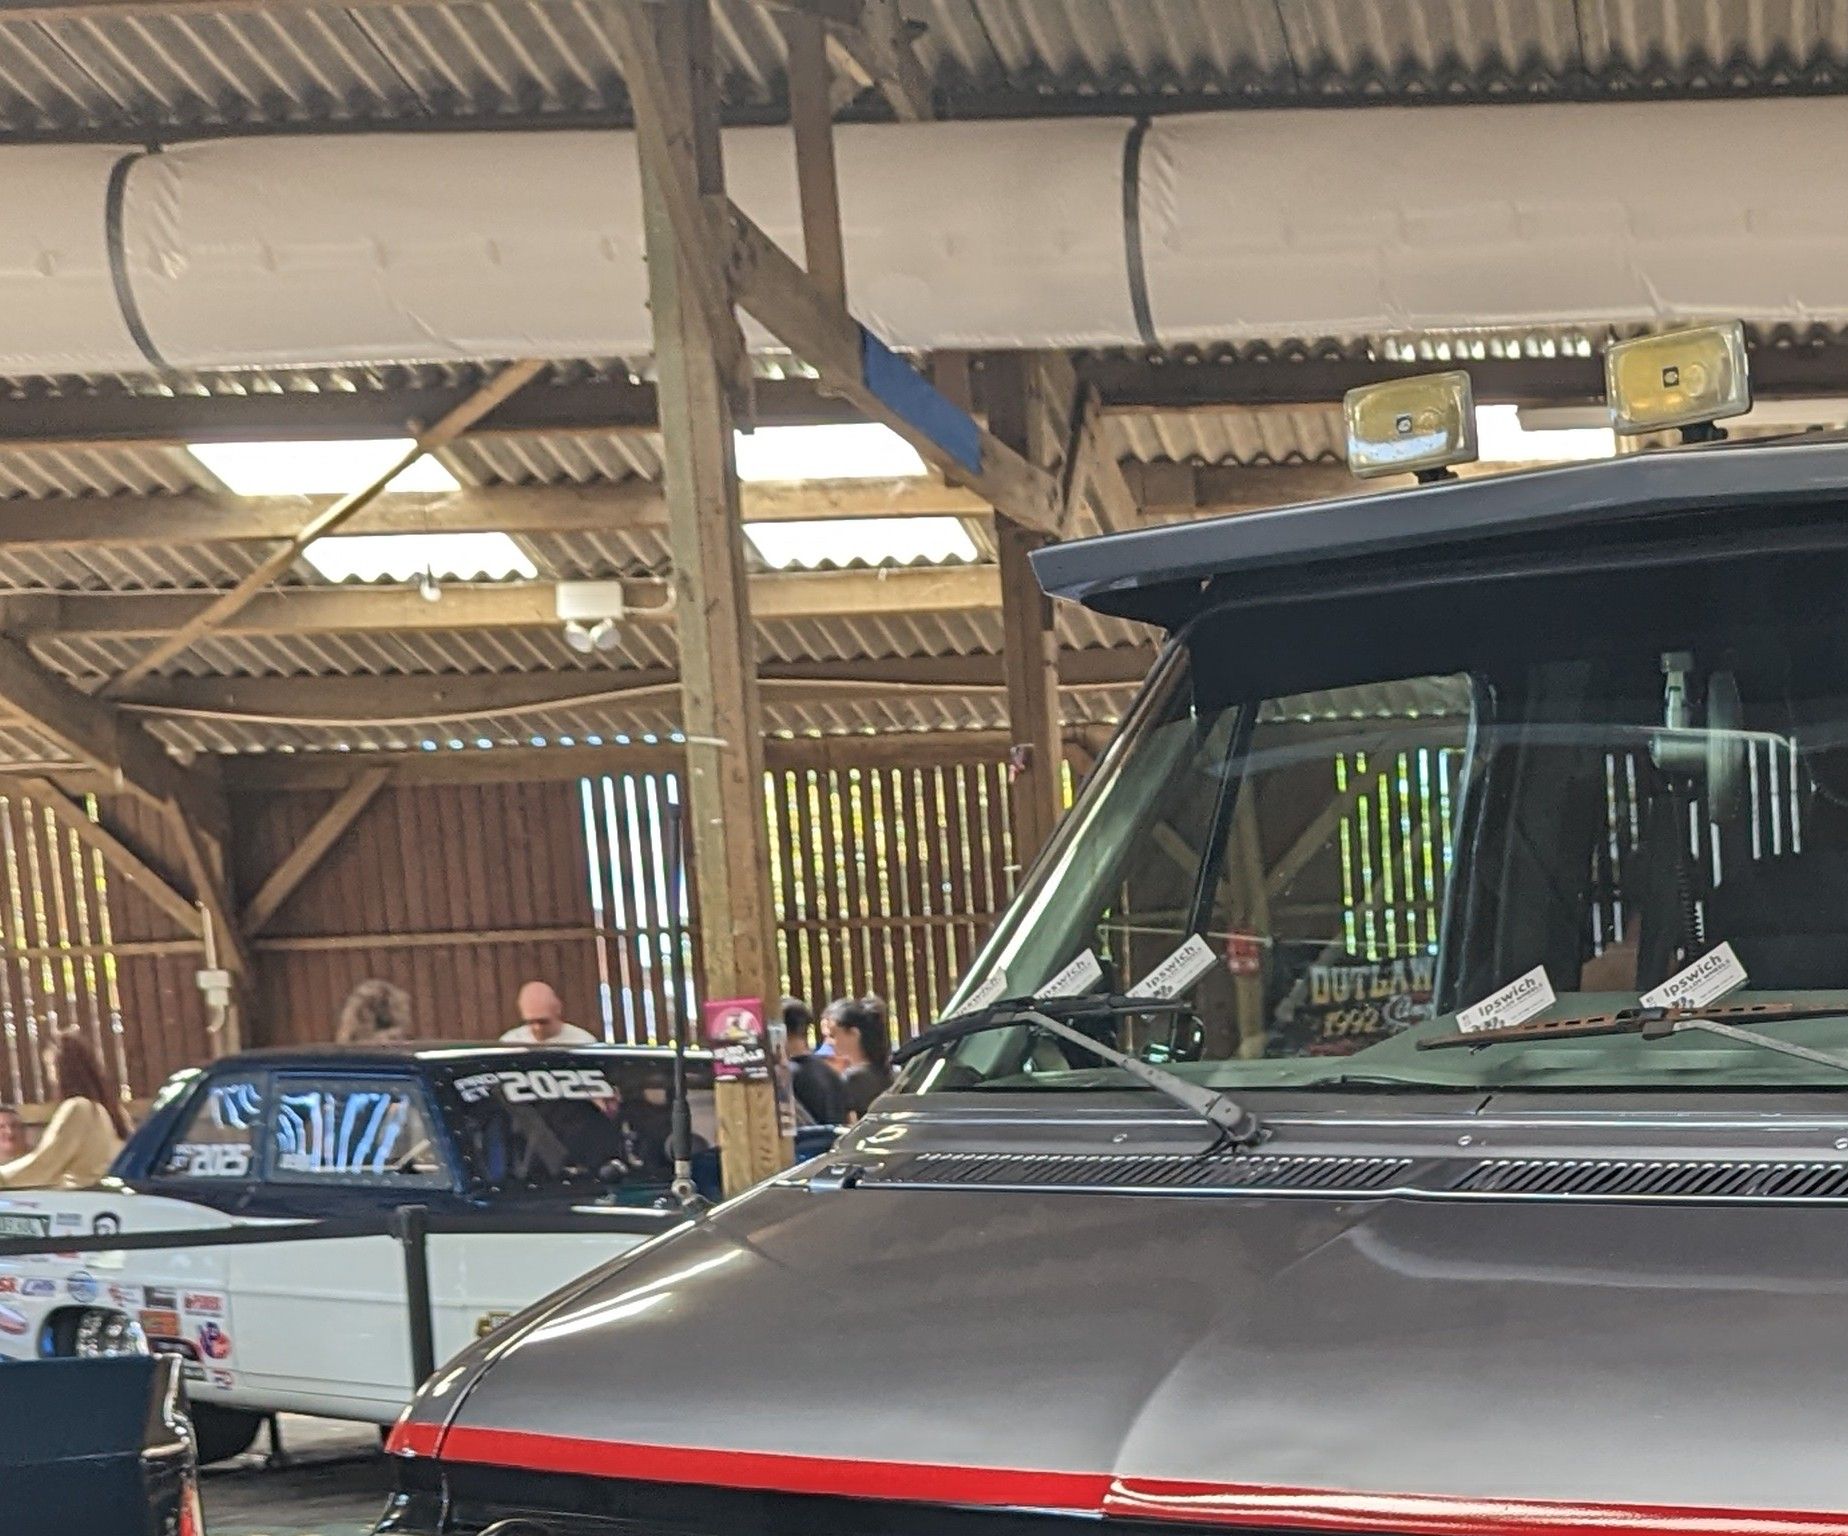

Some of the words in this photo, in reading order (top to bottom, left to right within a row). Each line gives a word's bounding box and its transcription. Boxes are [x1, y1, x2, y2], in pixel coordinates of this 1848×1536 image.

[1146, 945, 1195, 989] Ipswich
[1663, 955, 1721, 998] Ipswich
[1478, 978, 1536, 1016] Ipswich
[497, 1070, 614, 1102] 2025
